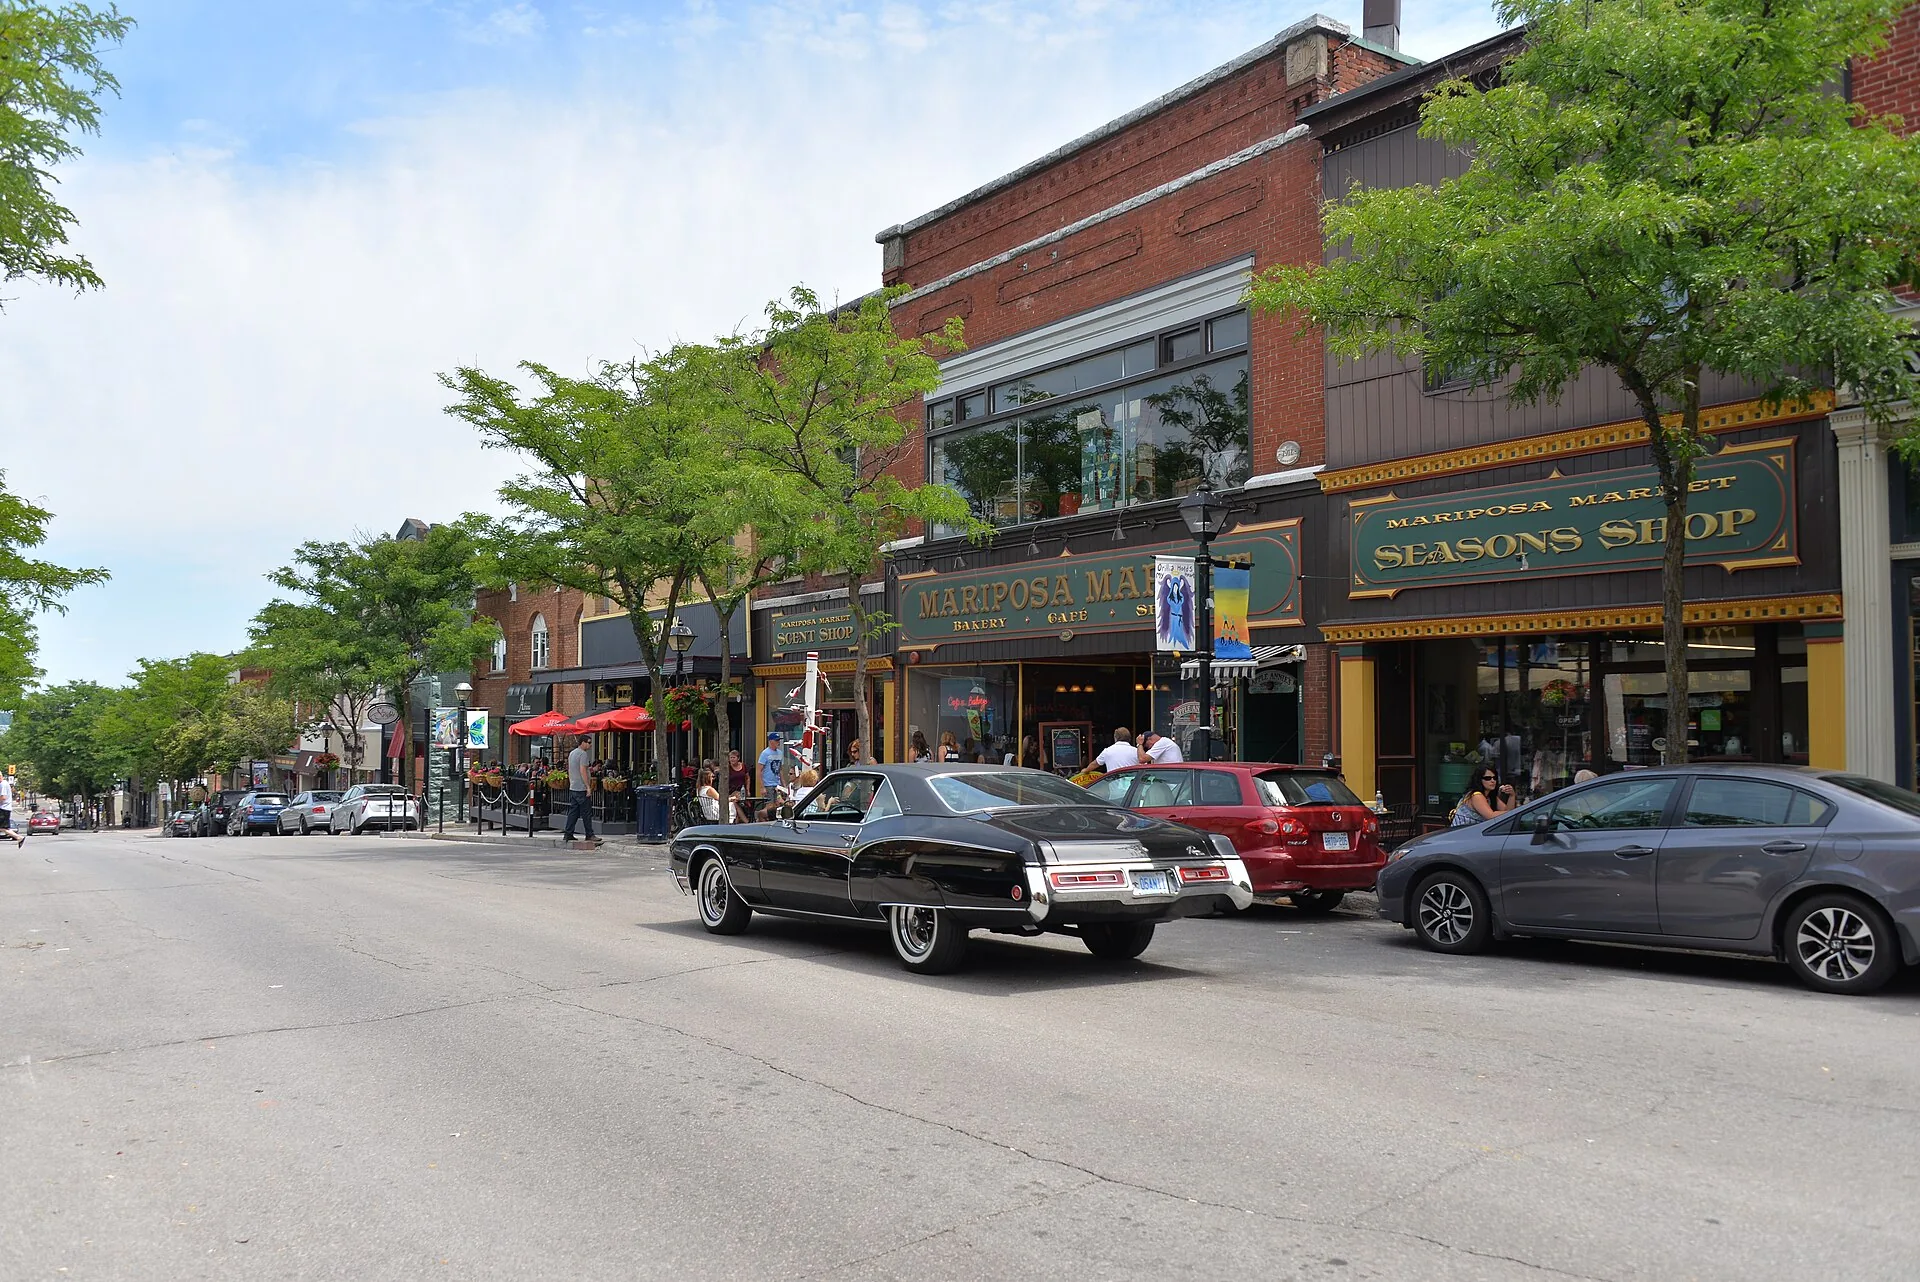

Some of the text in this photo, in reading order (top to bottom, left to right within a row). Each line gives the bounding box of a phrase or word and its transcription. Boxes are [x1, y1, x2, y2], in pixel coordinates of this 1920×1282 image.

[1385, 500, 1553, 529] MARIPOSA
[1373, 508, 1757, 571] SEASONS SHOP
[918, 574, 1075, 620] MARIPOSA
[780, 614, 851, 629] MARIPOSA MARKET
[953, 607, 1089, 632] BAKERY CAFÉ
[776, 626, 854, 646] SCENT SHOP
